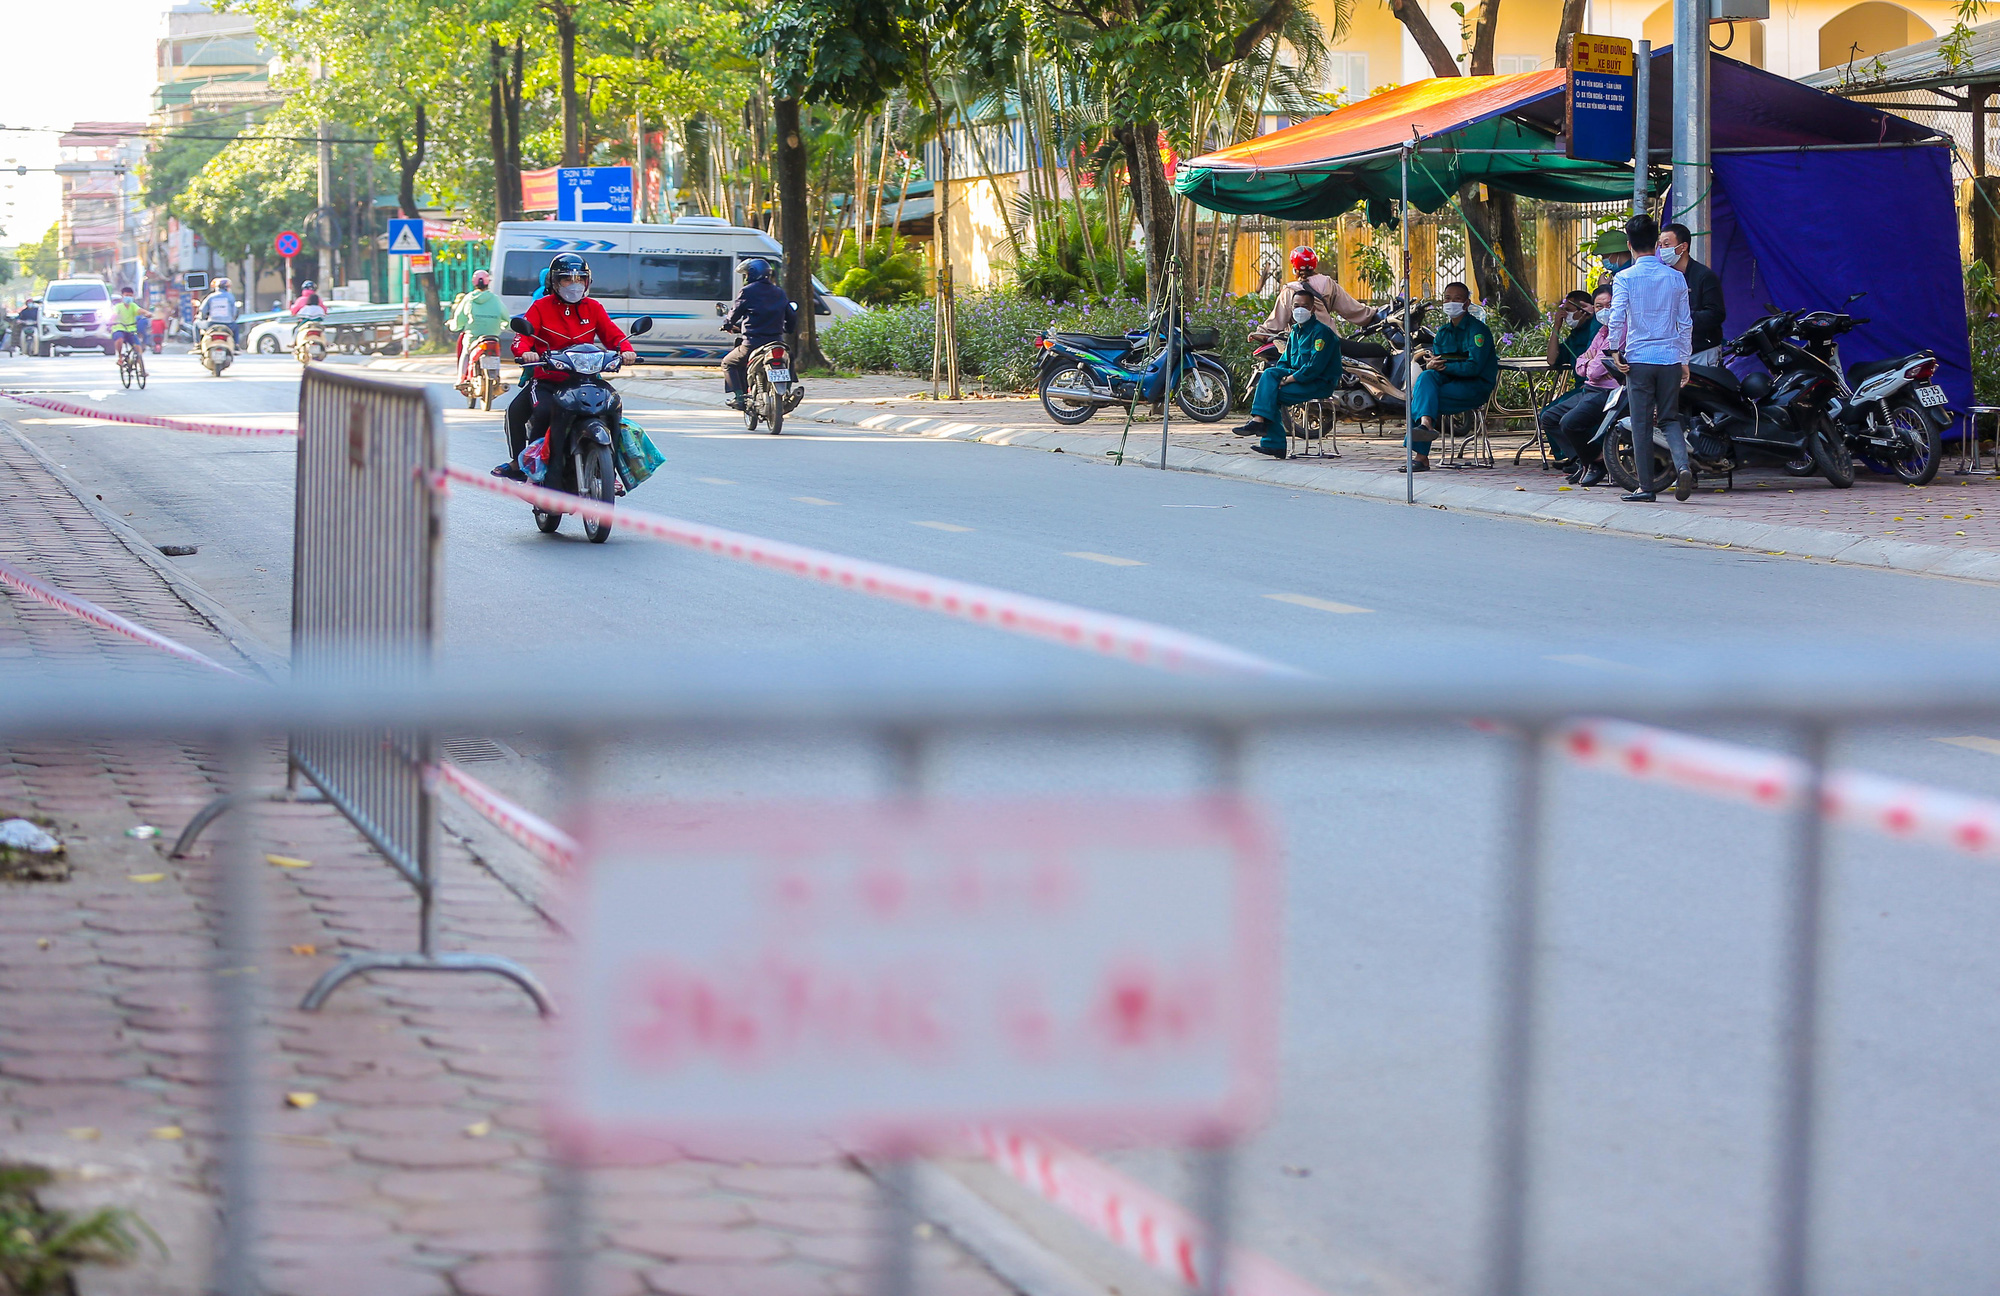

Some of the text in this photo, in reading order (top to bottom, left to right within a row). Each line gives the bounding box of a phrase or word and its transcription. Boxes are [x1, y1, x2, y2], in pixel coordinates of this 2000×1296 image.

[1594, 40, 1626, 56] ĐIỂM DỪNG
[1598, 58, 1622, 70] XE BUÝT
[582, 168, 595, 177] TÂY
[609, 184, 631, 193] CHÙA
